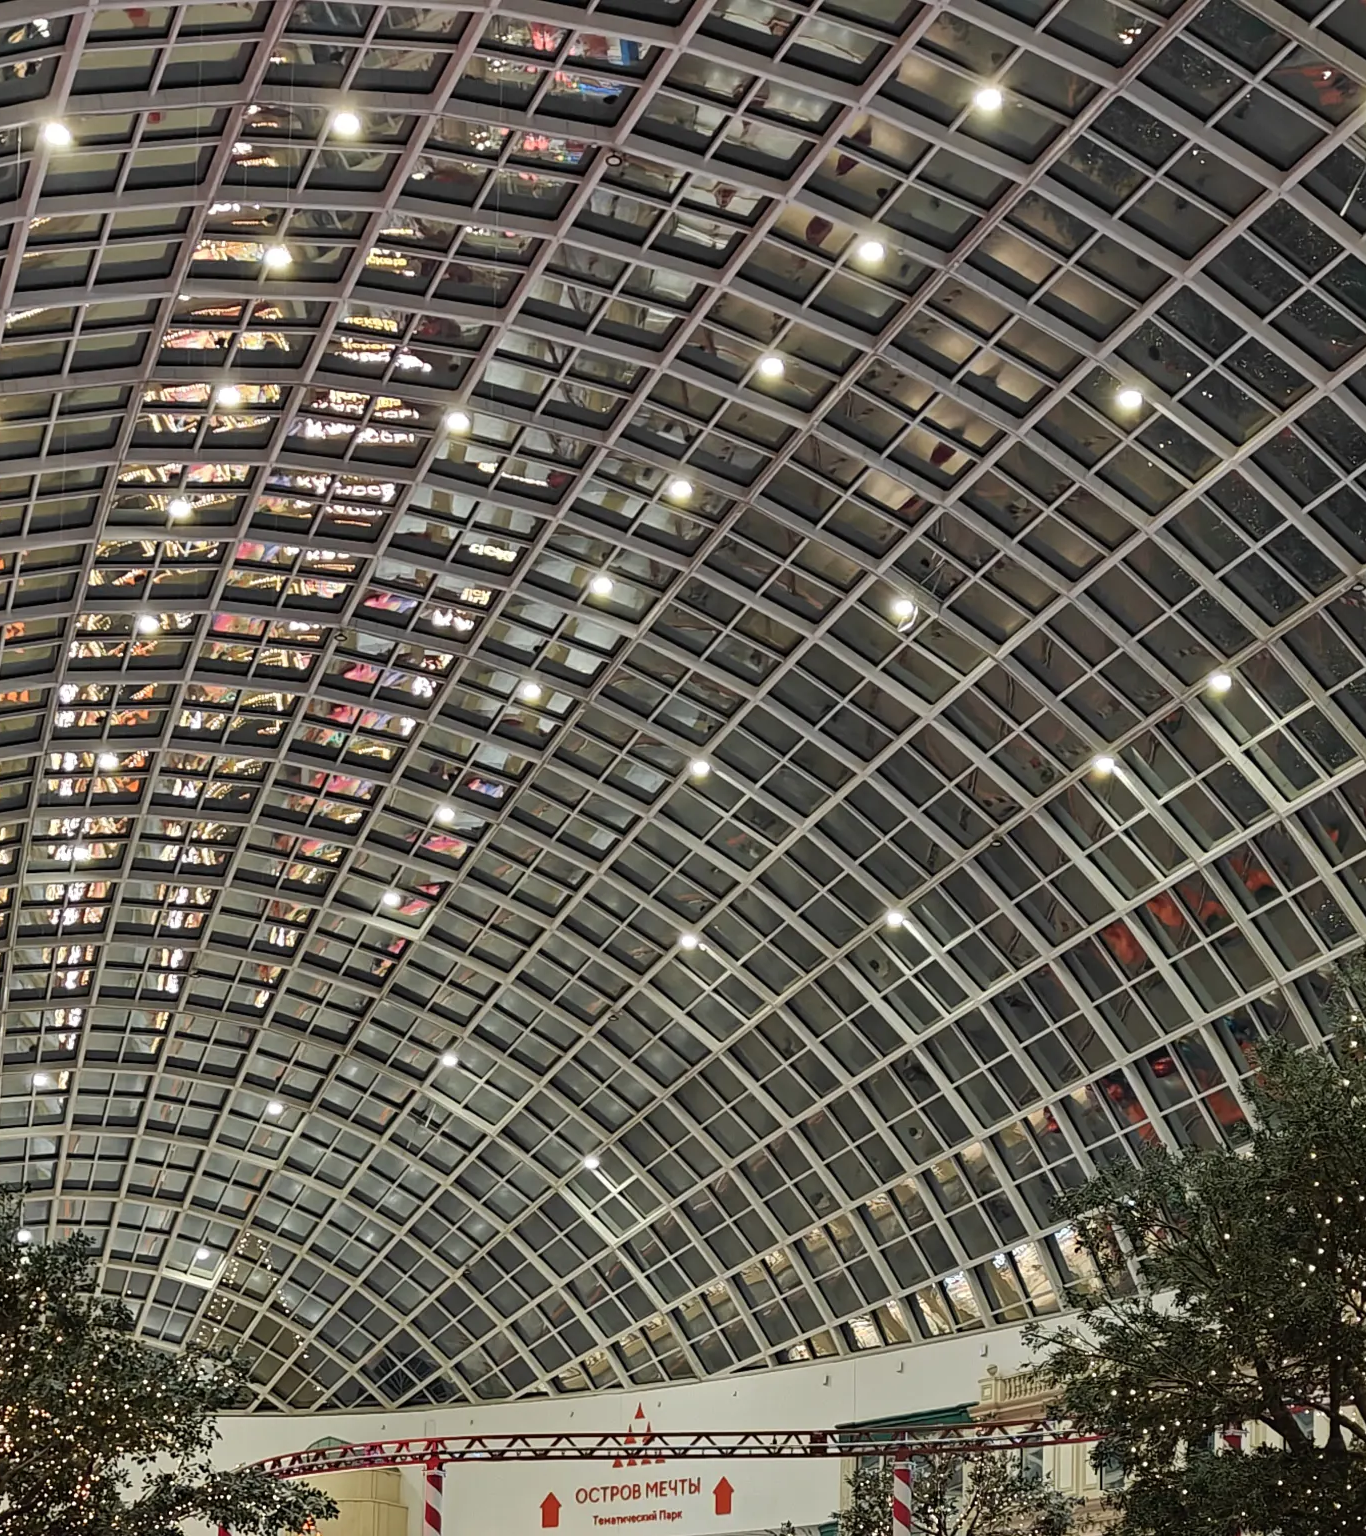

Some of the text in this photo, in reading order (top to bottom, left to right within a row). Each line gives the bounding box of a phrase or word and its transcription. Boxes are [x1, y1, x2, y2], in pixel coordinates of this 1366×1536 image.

[575, 1476, 701, 1504] ОСТРОВ МЕЧТЫ
[592, 1509, 683, 1526] Тематический Парк
